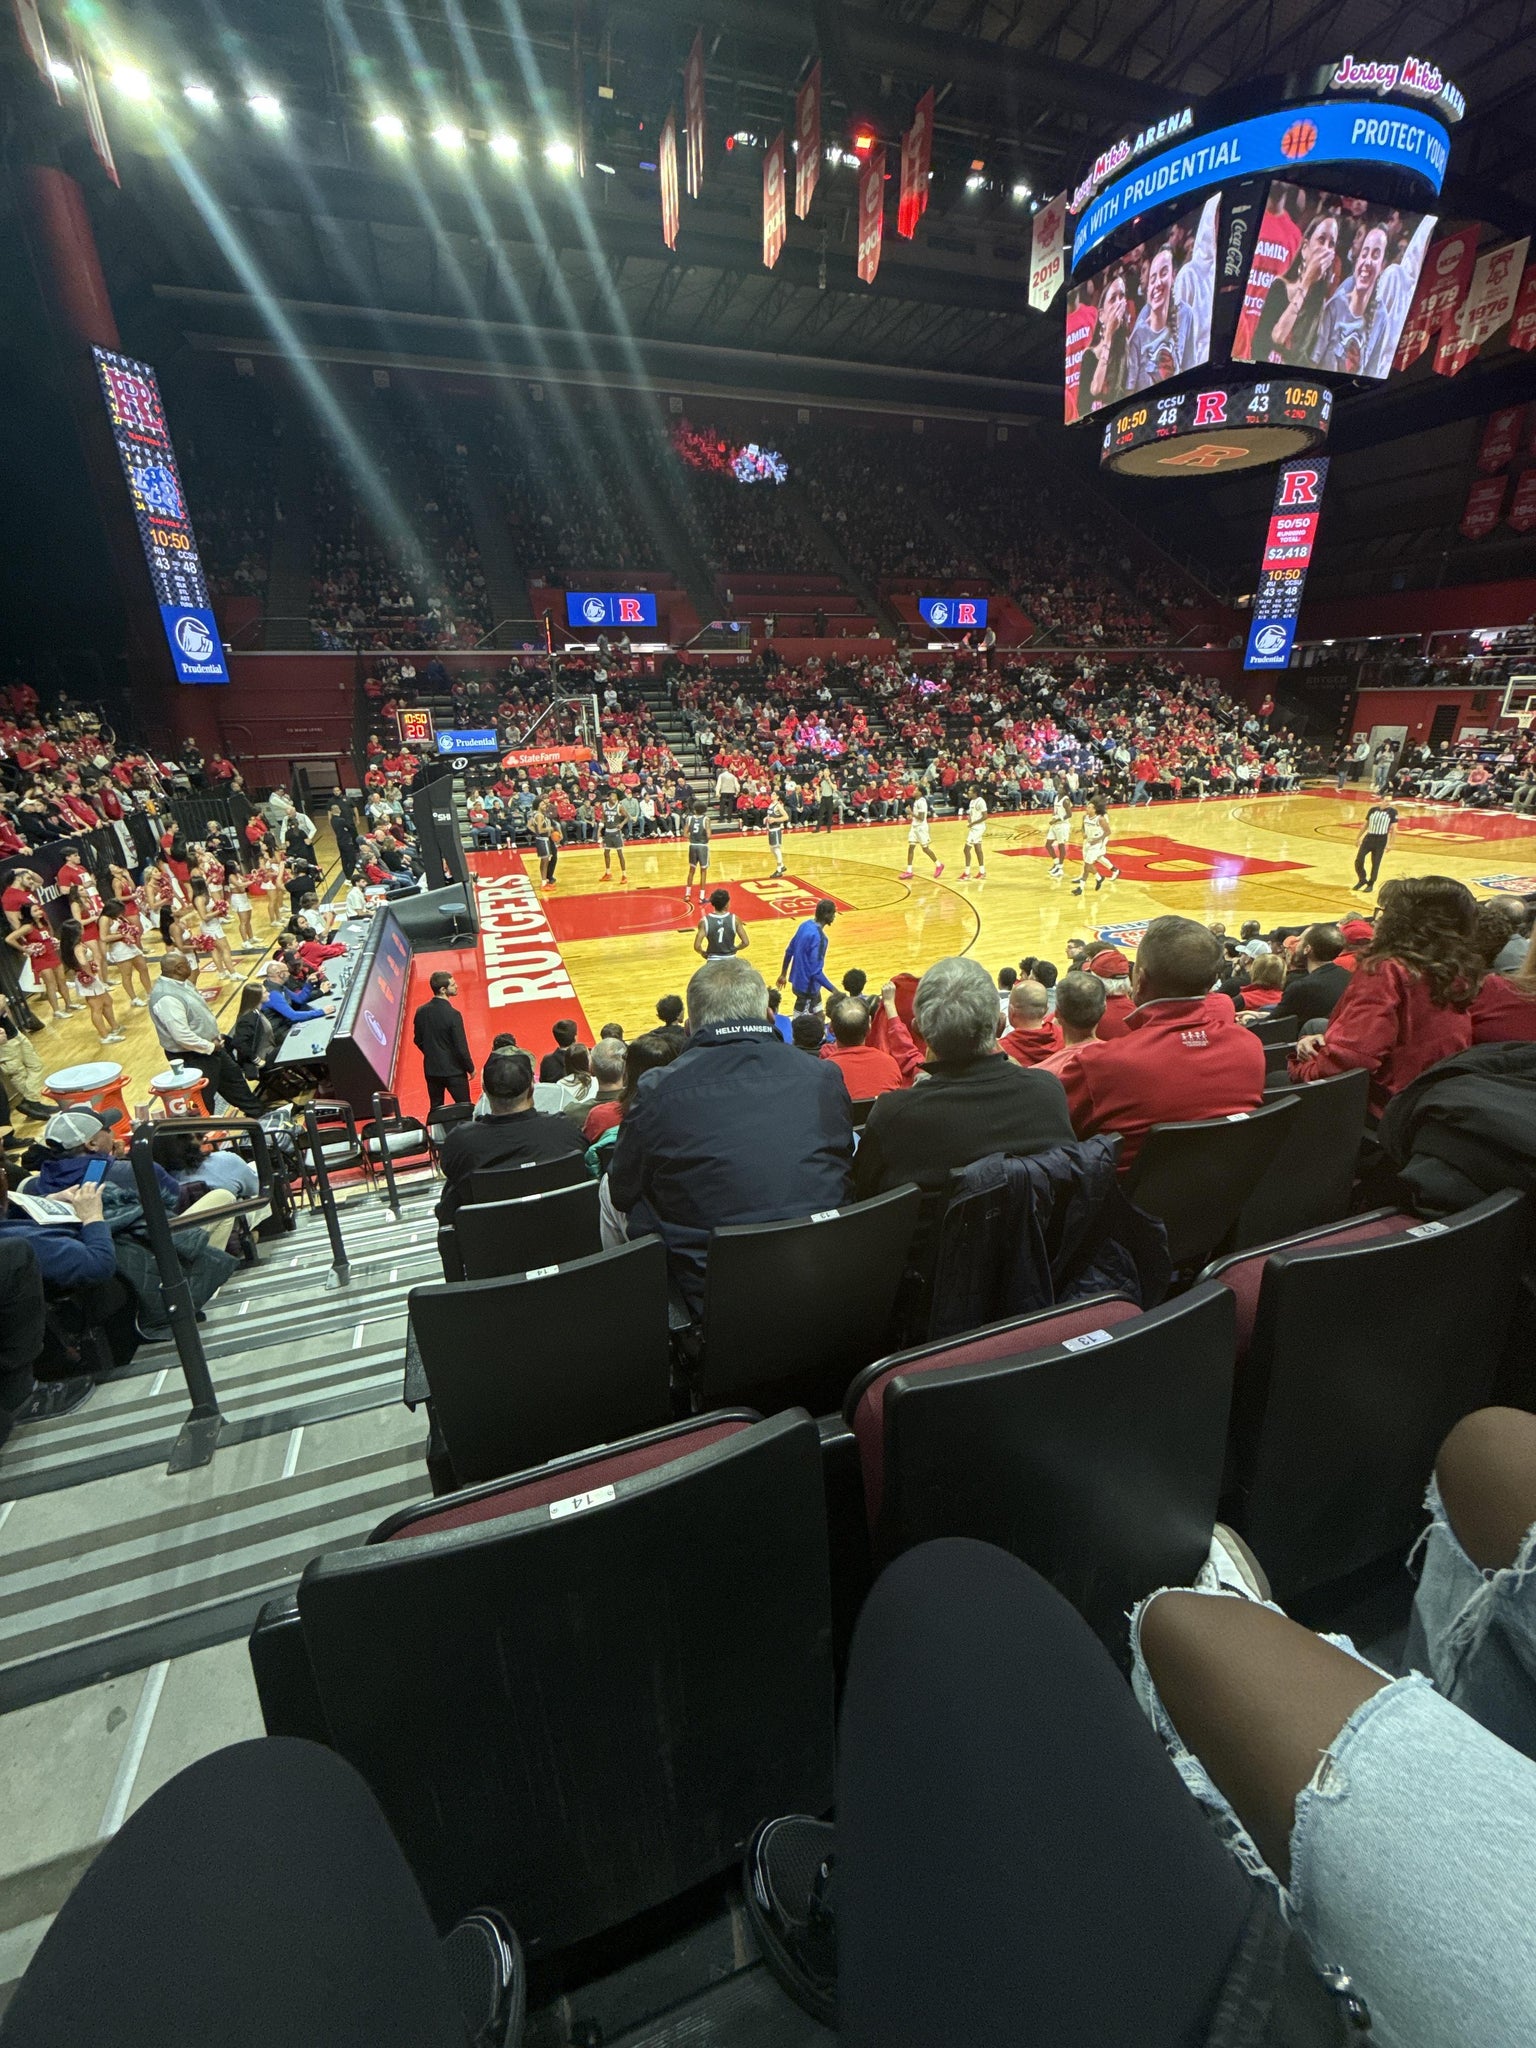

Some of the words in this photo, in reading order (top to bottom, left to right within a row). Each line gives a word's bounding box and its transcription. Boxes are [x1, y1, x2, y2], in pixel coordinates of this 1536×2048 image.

[1334, 54, 1399, 91] Jersey
[1400, 55, 1444, 94] Mike's
[1132, 107, 1193, 154] ARENA
[1351, 118, 1426, 155] PROTECT
[1090, 193, 1120, 236] WITH
[1123, 138, 1241, 210] PRUDENTIAL
[1032, 256, 1060, 289] 2019
[1420, 284, 1460, 314] 1979
[94, 347, 106, 360] PL
[106, 352, 117, 364] PT
[1255, 383, 1271, 394] RU
[1157, 394, 1186, 410] CCSU
[1247, 395, 1270, 413] 43
[1284, 387, 1318, 408] 10:50
[1193, 390, 1229, 426] R
[1116, 408, 1148, 435] 10:50
[1157, 408, 1178, 426] 48
[119, 440, 130, 451] PL
[131, 444, 140, 454] PT
[1279, 469, 1319, 506] R
[1277, 517, 1311, 530] 50/50
[150, 528, 190, 551] 10:50
[153, 546, 166, 556] RU
[177, 550, 199, 561] CCSU
[1268, 546, 1308, 561] $2,418
[156, 557, 170, 570] 43
[183, 561, 197, 574] 48
[1269, 569, 1301, 581] 10:50
[1263, 587, 1276, 597] 43
[1285, 586, 1298, 596] 48
[619, 598, 645, 622] R
[957, 603, 978, 624] R
[1250, 655, 1285, 664] Prudential
[181, 662, 223, 674] Prudential
[404, 713, 428, 724] 10:50
[407, 724, 425, 738] 20
[456, 737, 496, 747] Prudential
[437, 812, 452, 821] SHI
[693, 823, 700, 833] 5
[477, 874, 576, 1008] RUTGERS
[717, 926, 725, 943] 1
[715, 1026, 741, 1036] HELLY
[742, 1025, 773, 1036] HANSEN
[169, 1097, 187, 1115] G
[1418, 1225, 1437, 1233] 12
[537, 1268, 548, 1276] 14
[1077, 1335, 1097, 1346] 13
[572, 1494, 594, 1510] 14
